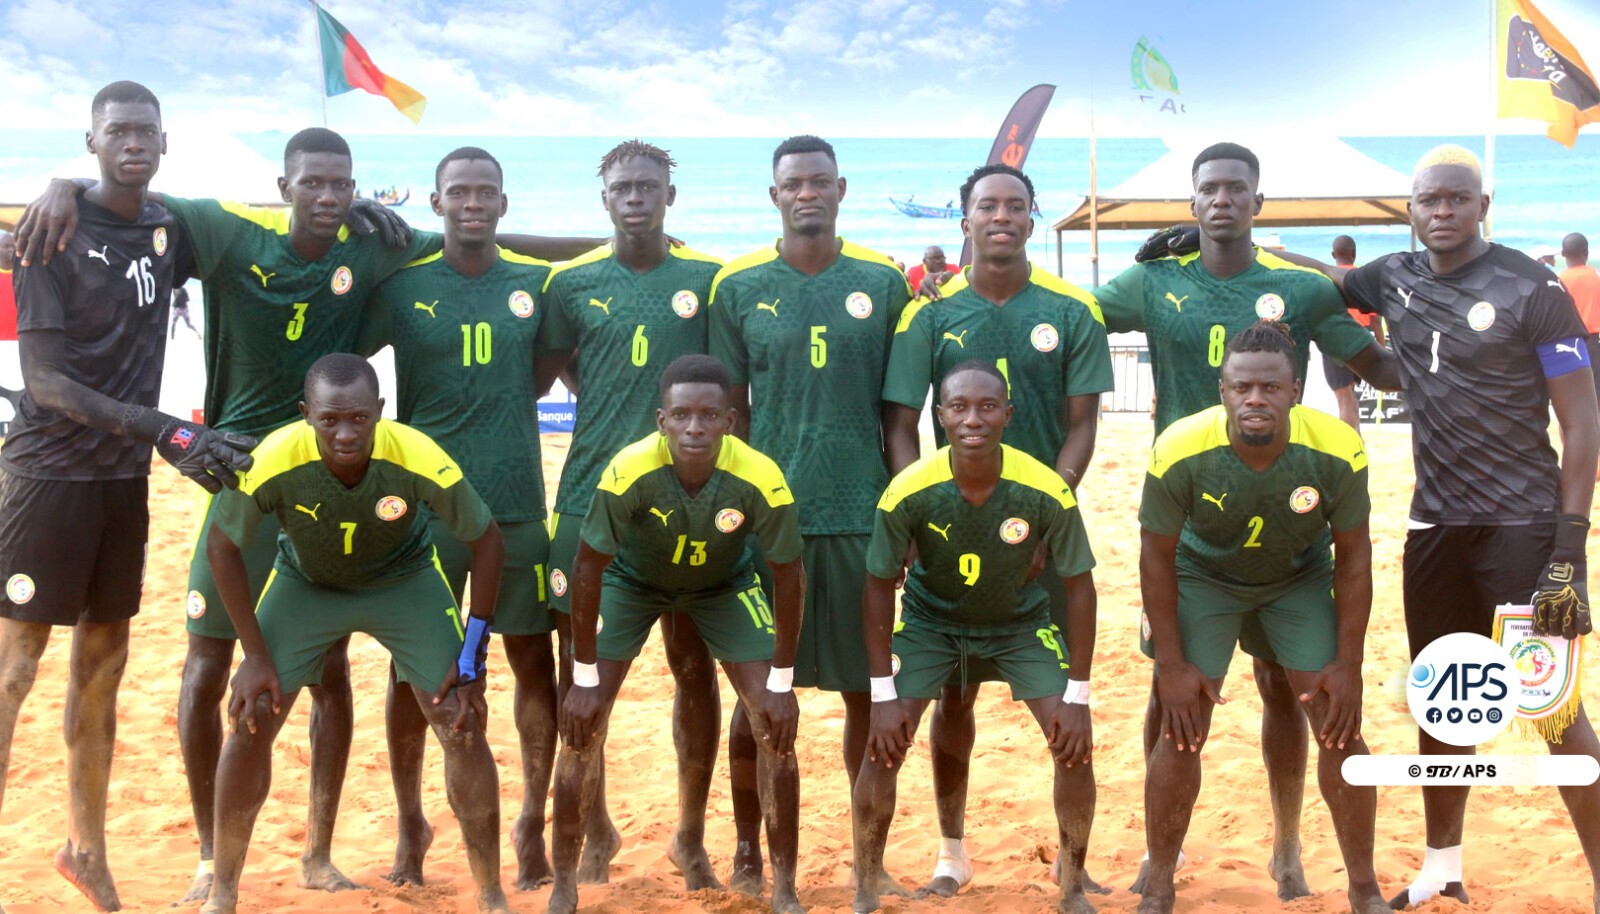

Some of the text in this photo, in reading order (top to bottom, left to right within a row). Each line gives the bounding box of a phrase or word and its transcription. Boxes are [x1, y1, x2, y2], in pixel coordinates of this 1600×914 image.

[126, 256, 155, 307] 16
[286, 303, 309, 341] 3
[461, 322, 491, 366] 10
[632, 325, 648, 367] 6
[811, 325, 827, 369] 5
[1208, 324, 1226, 368] 8
[1429, 330, 1440, 374] 1
[537, 410, 573, 424] Banque
[340, 522, 357, 555] 7
[671, 534, 707, 566] 13
[1243, 516, 1264, 548] 2
[959, 553, 980, 586] 9
[737, 586, 773, 629] 13
[1036, 628, 1064, 660] 9
